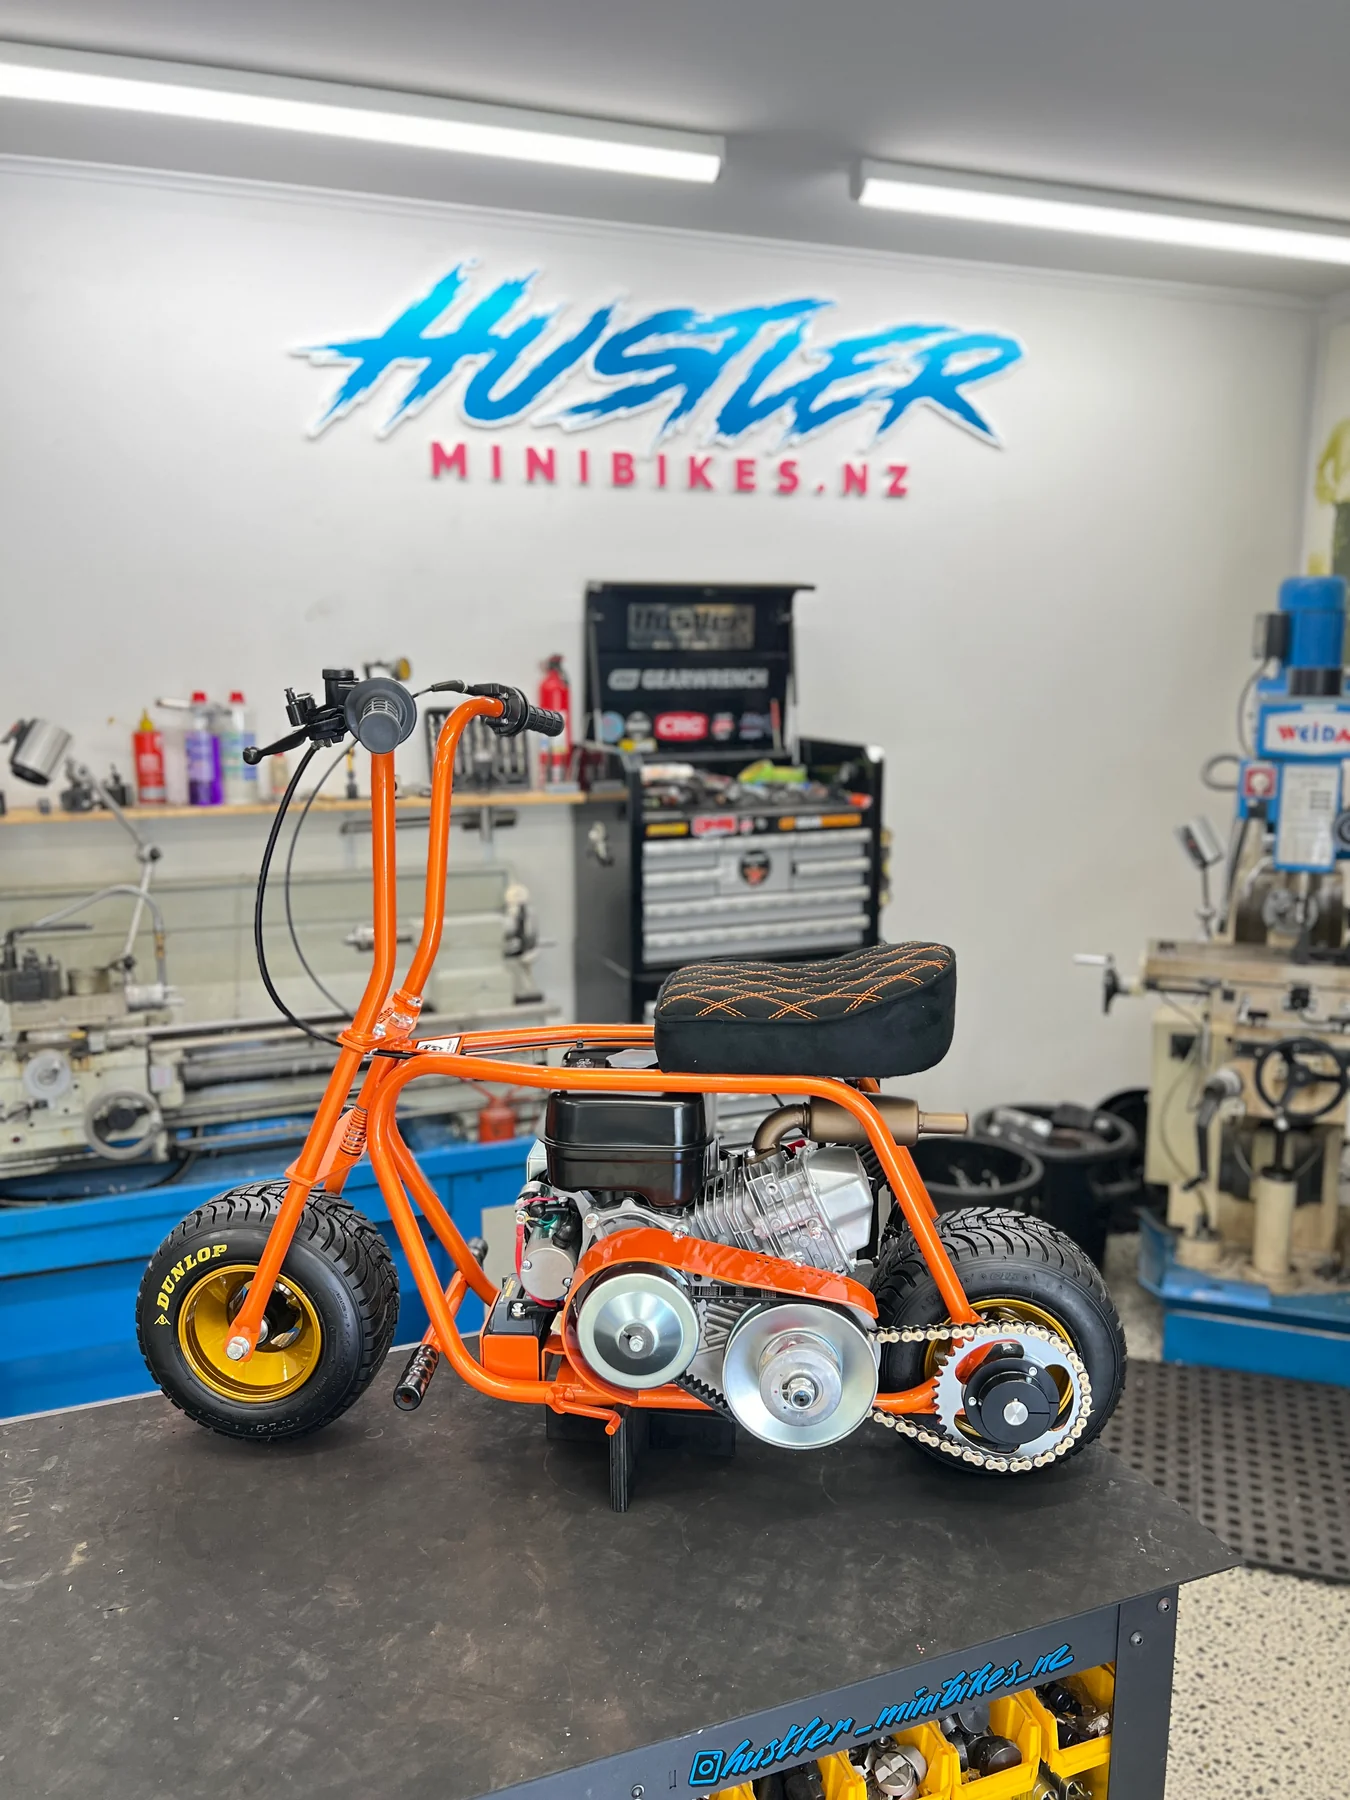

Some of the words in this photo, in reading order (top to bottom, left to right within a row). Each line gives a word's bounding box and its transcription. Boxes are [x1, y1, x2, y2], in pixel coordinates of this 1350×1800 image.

[300, 262, 1022, 448] HUSTLER
[430, 441, 909, 498] MINIBIKES.NZ
[641, 668, 769, 690] GEARWRENCH
[157, 1244, 228, 1311] DUNLOP
[719, 1643, 1075, 1779] hustler_minibikes_nz
